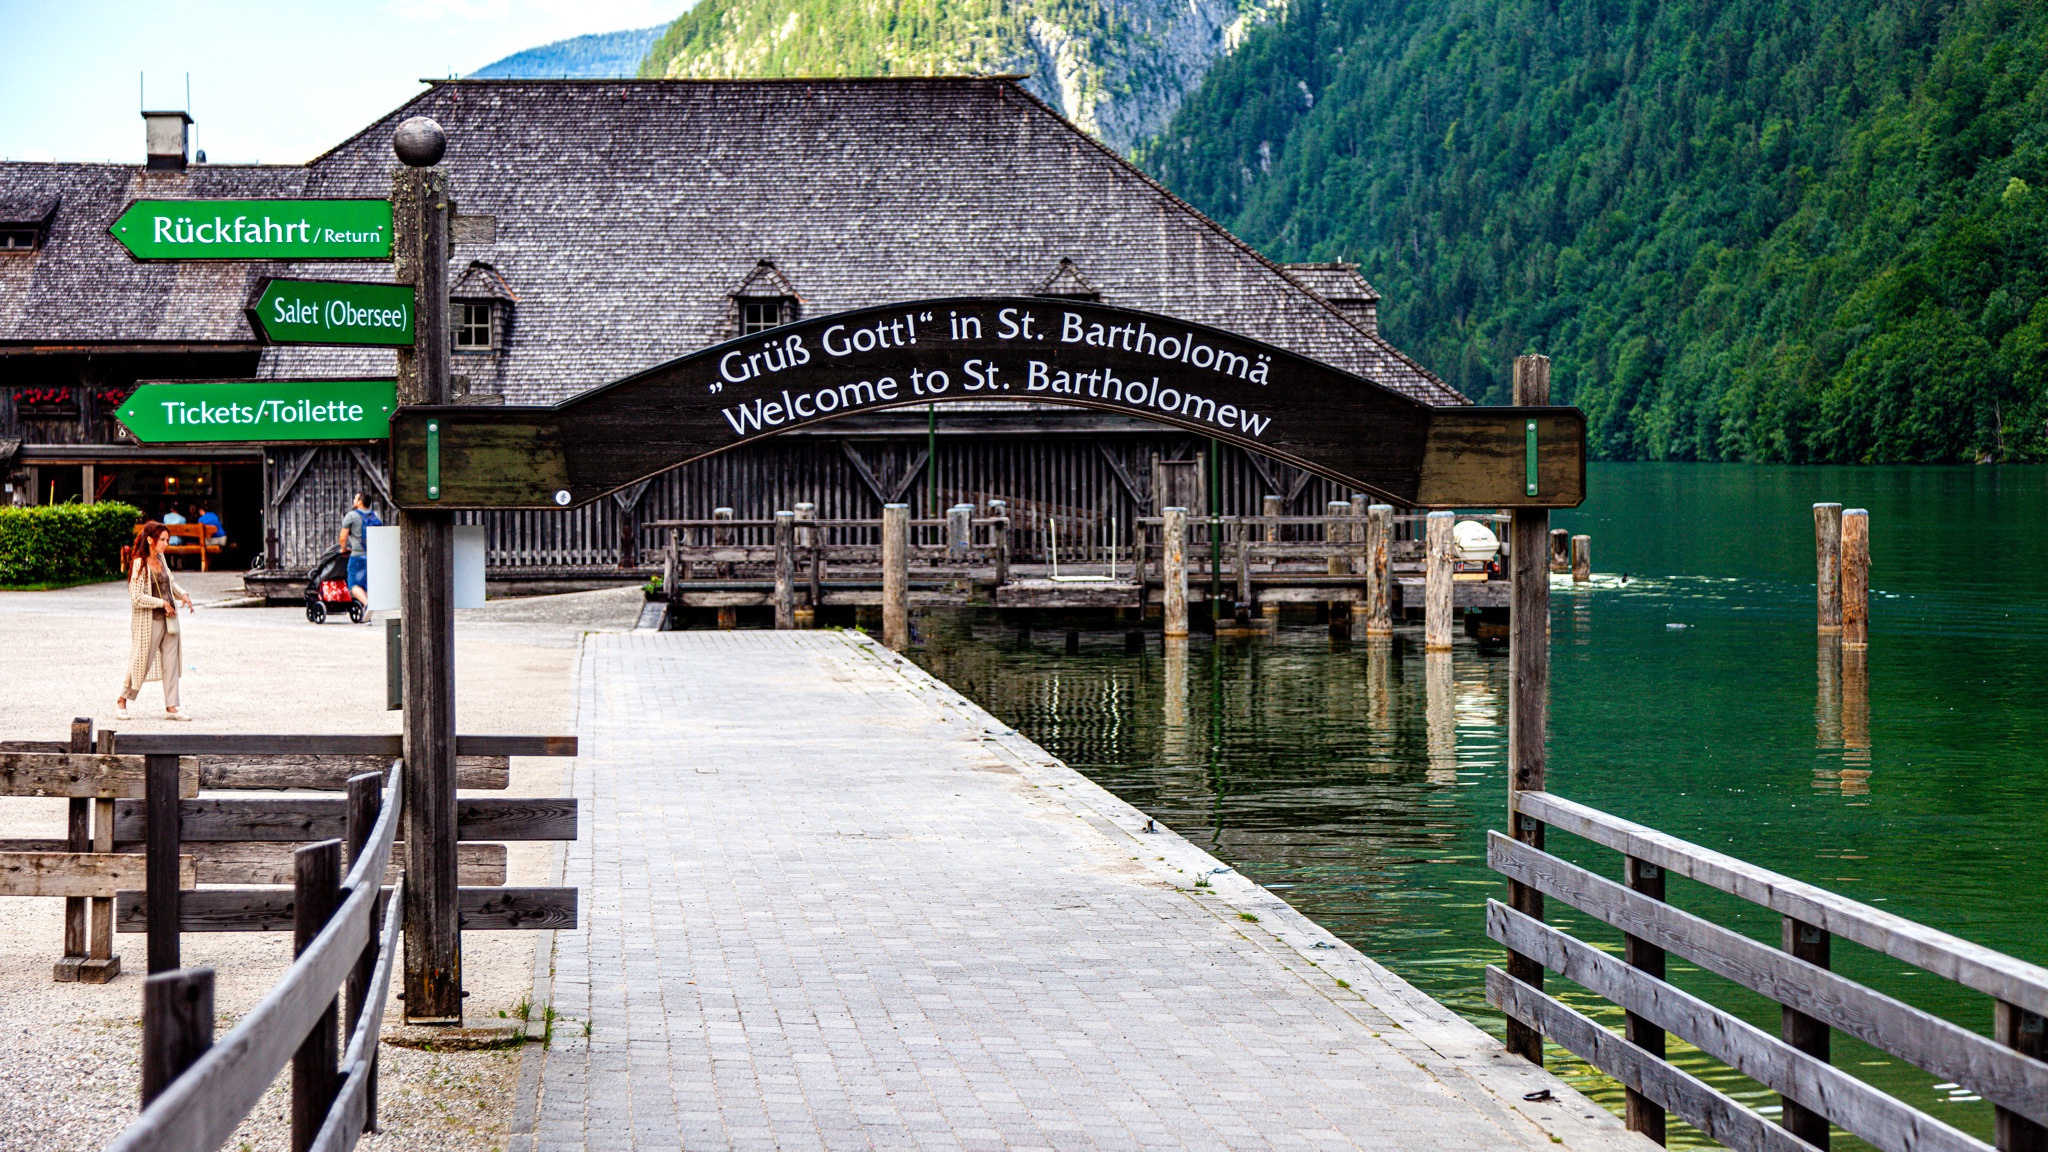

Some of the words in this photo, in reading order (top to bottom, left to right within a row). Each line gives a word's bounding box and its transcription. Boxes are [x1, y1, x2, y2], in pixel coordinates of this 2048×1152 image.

[154, 216, 311, 243] Rückfahrt
[324, 229, 380, 243] Return
[274, 296, 319, 325] Salet
[325, 301, 407, 332] (Obersee)
[709, 335, 811, 394] „Grüß
[822, 311, 933, 357] Gott!“
[950, 310, 983, 339] in
[998, 309, 1044, 341] St.
[1060, 312, 1272, 387] Bartholomä
[161, 400, 364, 425] Tickets/Toilette
[722, 378, 898, 435] Welcome
[910, 368, 950, 394] to
[963, 360, 1010, 391] St.
[1027, 361, 1272, 437] Bartholomew
